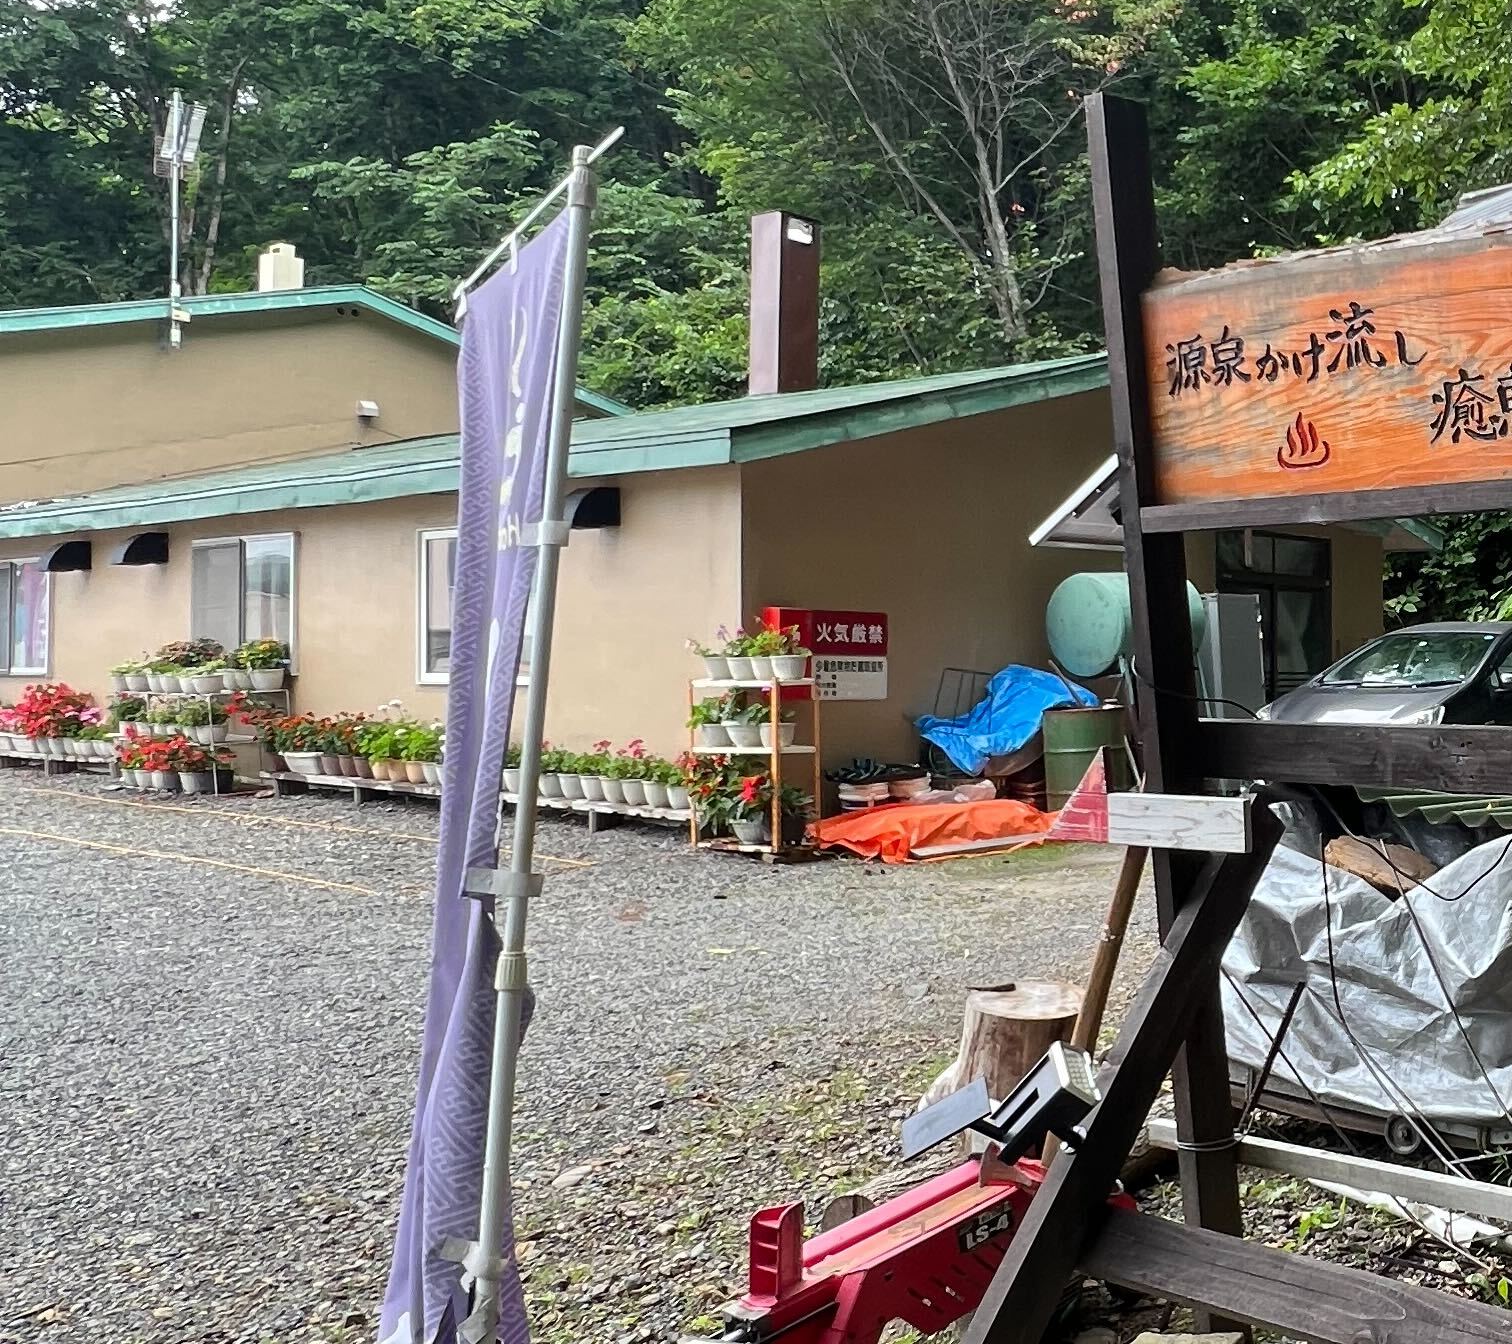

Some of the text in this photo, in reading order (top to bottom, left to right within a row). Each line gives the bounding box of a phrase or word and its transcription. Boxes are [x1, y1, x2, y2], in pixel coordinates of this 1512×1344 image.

[1165, 301, 1428, 398] 源泉かけ流し
[816, 622, 883, 644] 火気厳禁
[966, 1213, 1009, 1250] LS-4
